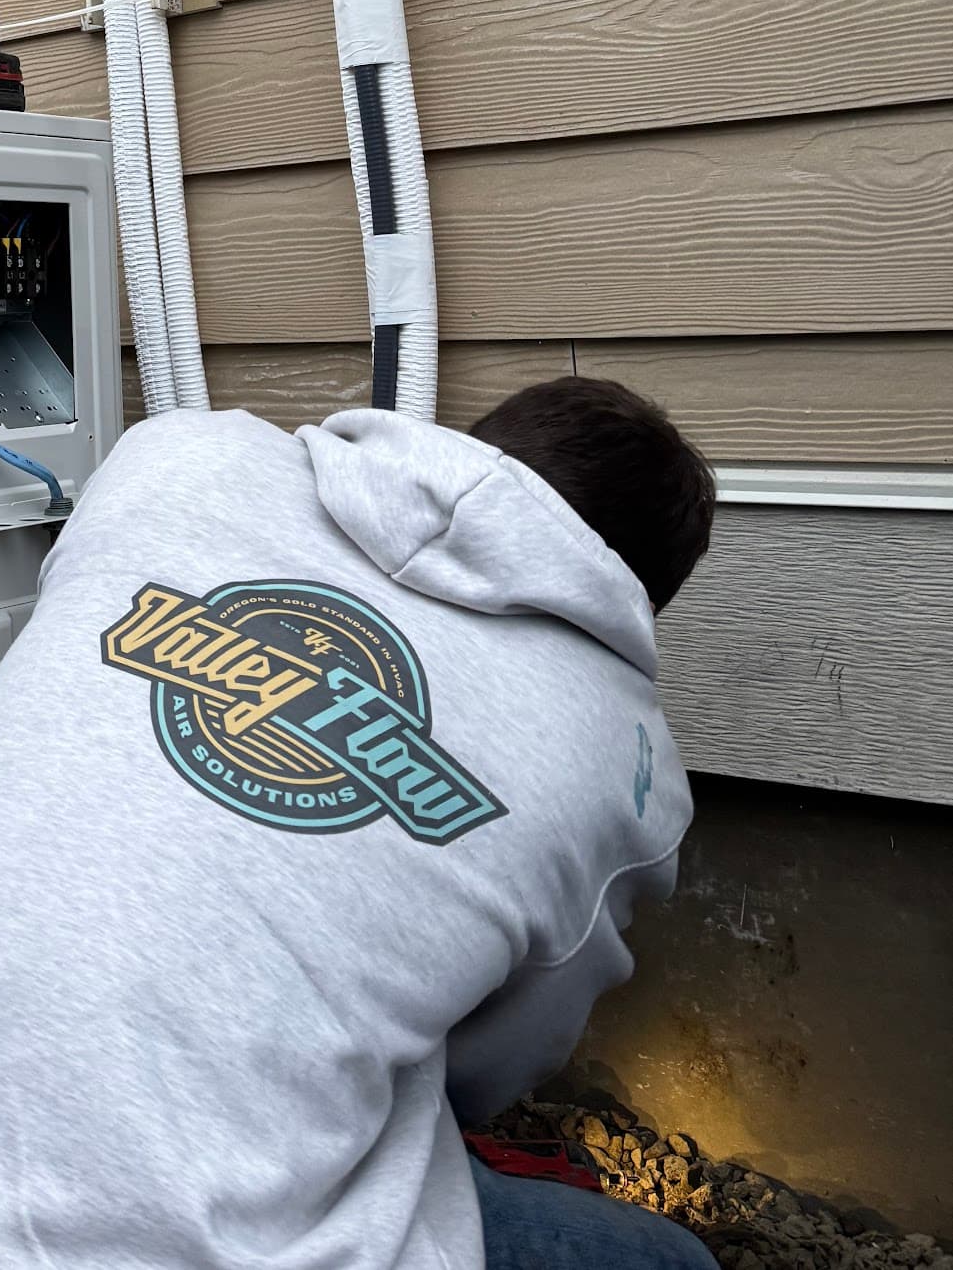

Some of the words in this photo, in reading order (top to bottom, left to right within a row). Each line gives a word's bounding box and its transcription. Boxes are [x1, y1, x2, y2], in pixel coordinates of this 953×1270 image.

[119, 588, 320, 736] Valley
[219, 596, 278, 619] OREGON'S
[282, 598, 317, 609] GOLD
[322, 606, 381, 645] STANDARD
[380, 647, 392, 661] IN
[389, 663, 405, 699] HVAC
[172, 695, 194, 739] AIR
[191, 743, 359, 809] SOLUTIONS
[301, 666, 470, 821] Flow
